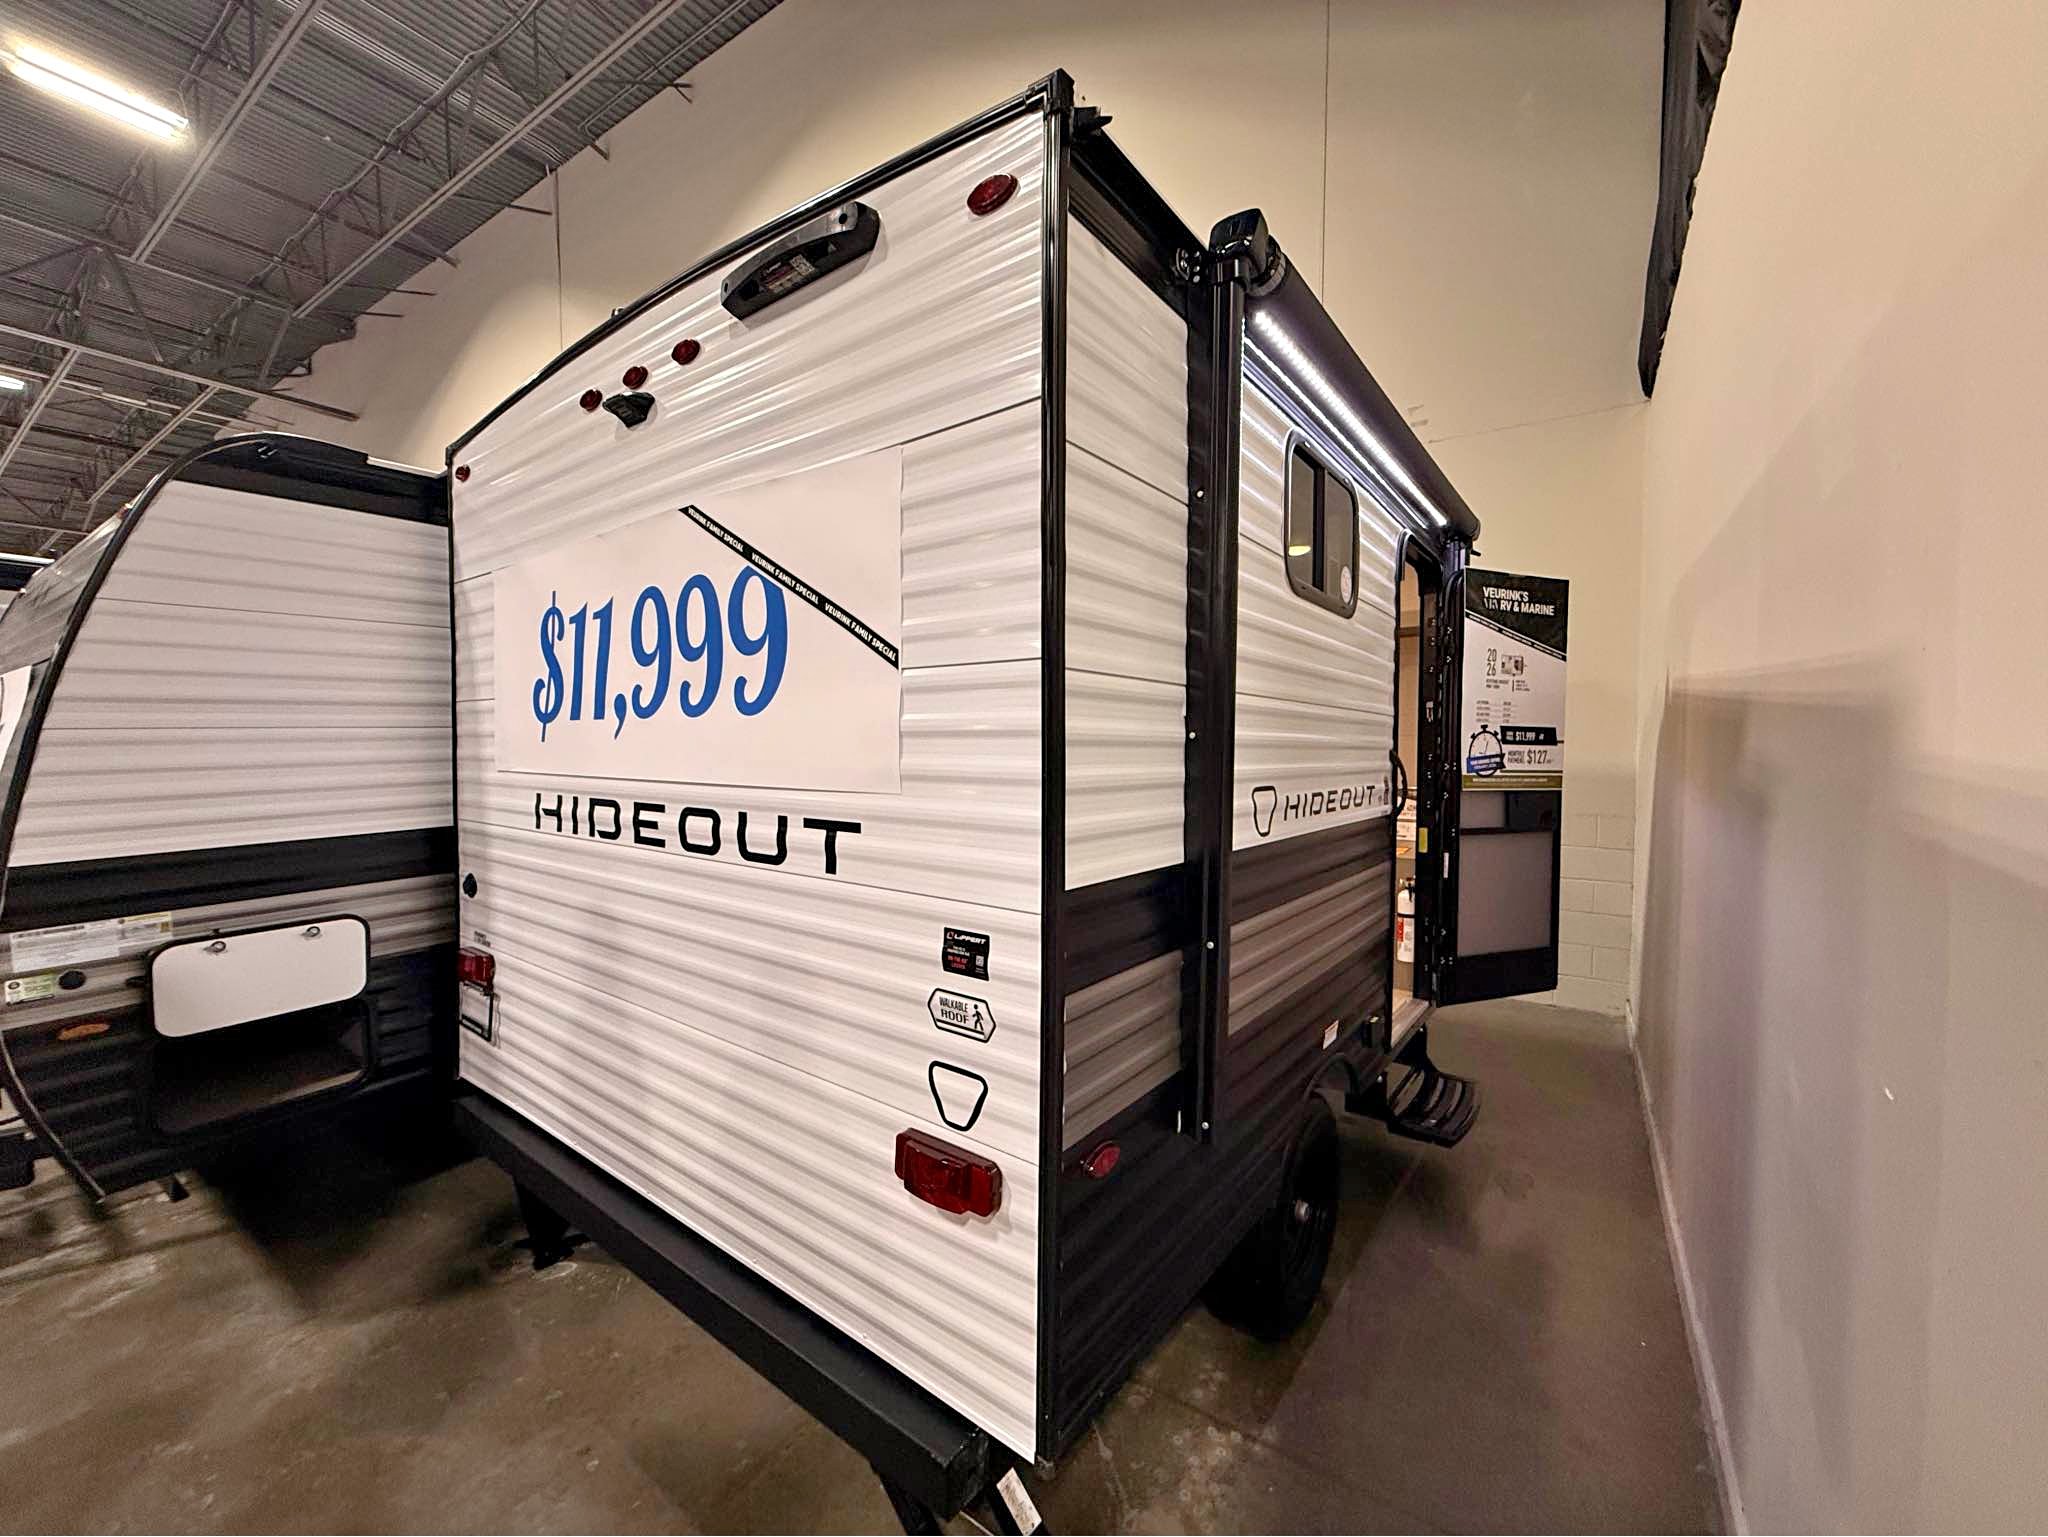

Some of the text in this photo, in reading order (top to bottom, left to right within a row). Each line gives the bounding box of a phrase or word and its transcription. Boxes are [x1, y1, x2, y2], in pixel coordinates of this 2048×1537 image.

[688, 507, 744, 552] VEURINK FAMILY SPECIAL
[751, 552, 819, 605] VEURINK FAMILY SPECIAL
[1482, 586, 1529, 602] VEURINK'S
[1500, 599, 1512, 611] RV
[1513, 601, 1520, 613] &
[1520, 602, 1555, 616] MARINE
[824, 603, 896, 661] VEURINK FAMILY SPECIAL
[533, 565, 788, 743] $11,999
[1526, 748, 1548, 765] $127
[1283, 785, 1376, 821] HIDEOUT
[534, 792, 862, 875] HIDEOUT
[954, 933, 987, 945] LIPPERT
[938, 996, 969, 1013] WALKABLE
[940, 1009, 970, 1025] ROOF
